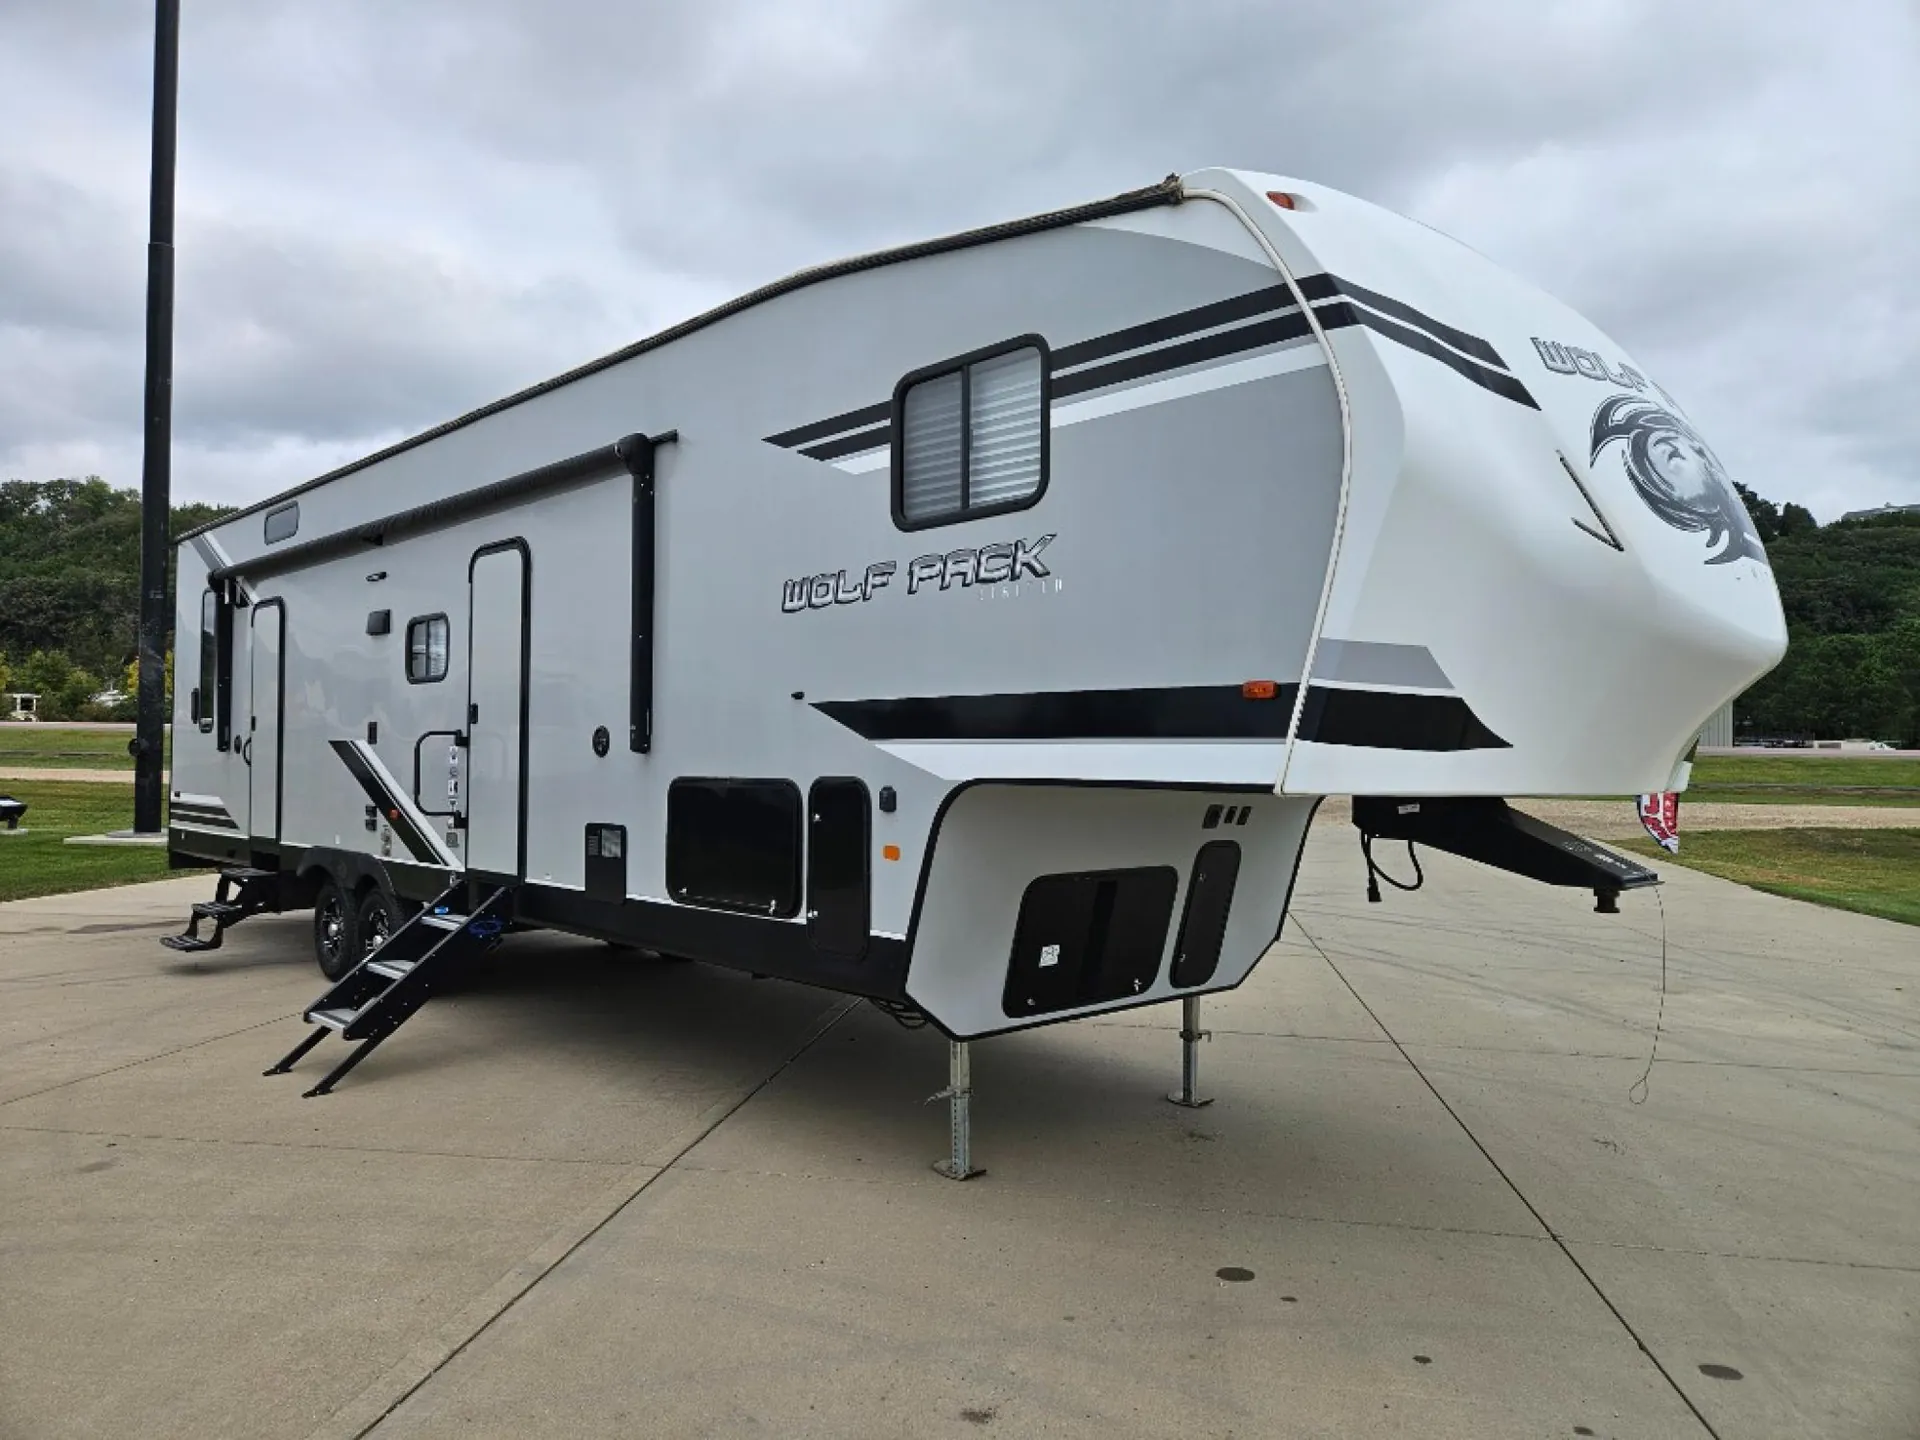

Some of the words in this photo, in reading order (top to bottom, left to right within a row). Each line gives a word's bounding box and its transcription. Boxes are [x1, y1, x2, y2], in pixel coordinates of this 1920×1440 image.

[1529, 337, 1648, 392] WOLF
[781, 560, 897, 613] WOLF
[907, 533, 1057, 594] PACK
